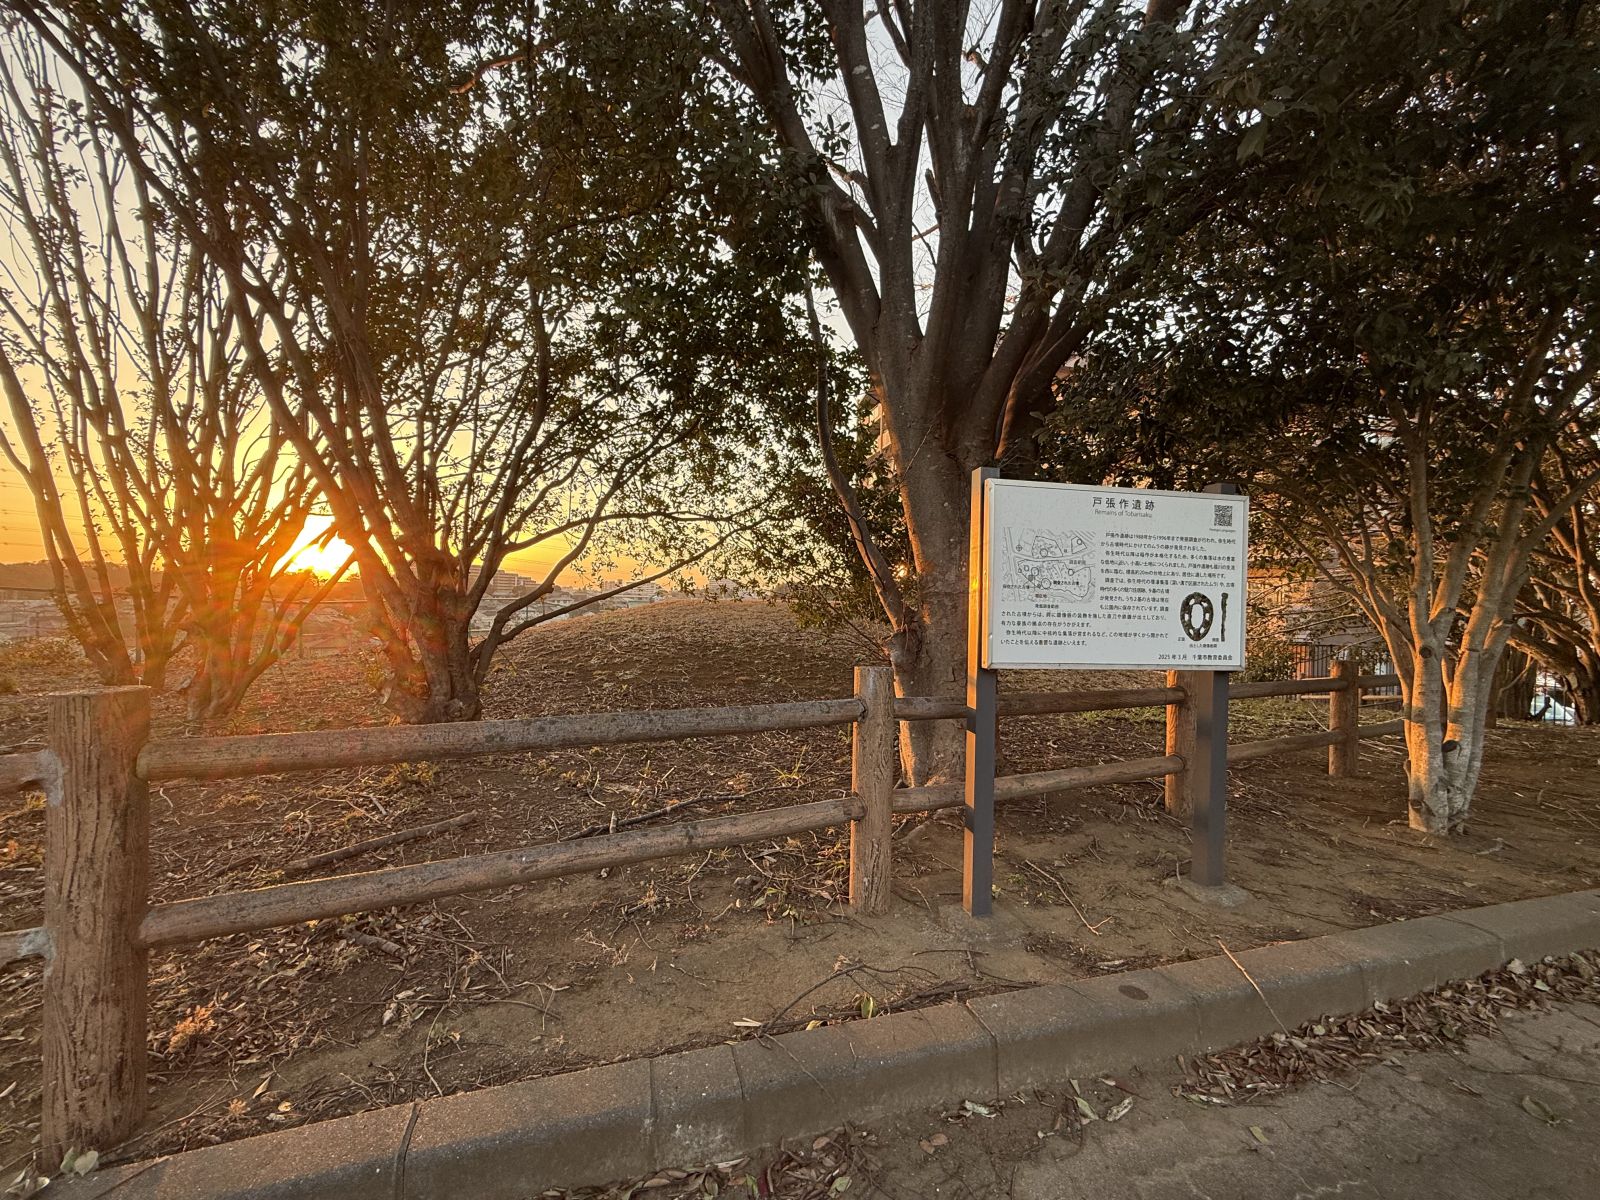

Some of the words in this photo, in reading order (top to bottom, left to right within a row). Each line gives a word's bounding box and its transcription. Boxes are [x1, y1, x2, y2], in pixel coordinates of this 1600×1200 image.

[1092, 496, 1155, 511] 戸張作遺跡
[1094, 508, 1117, 516] Remains
